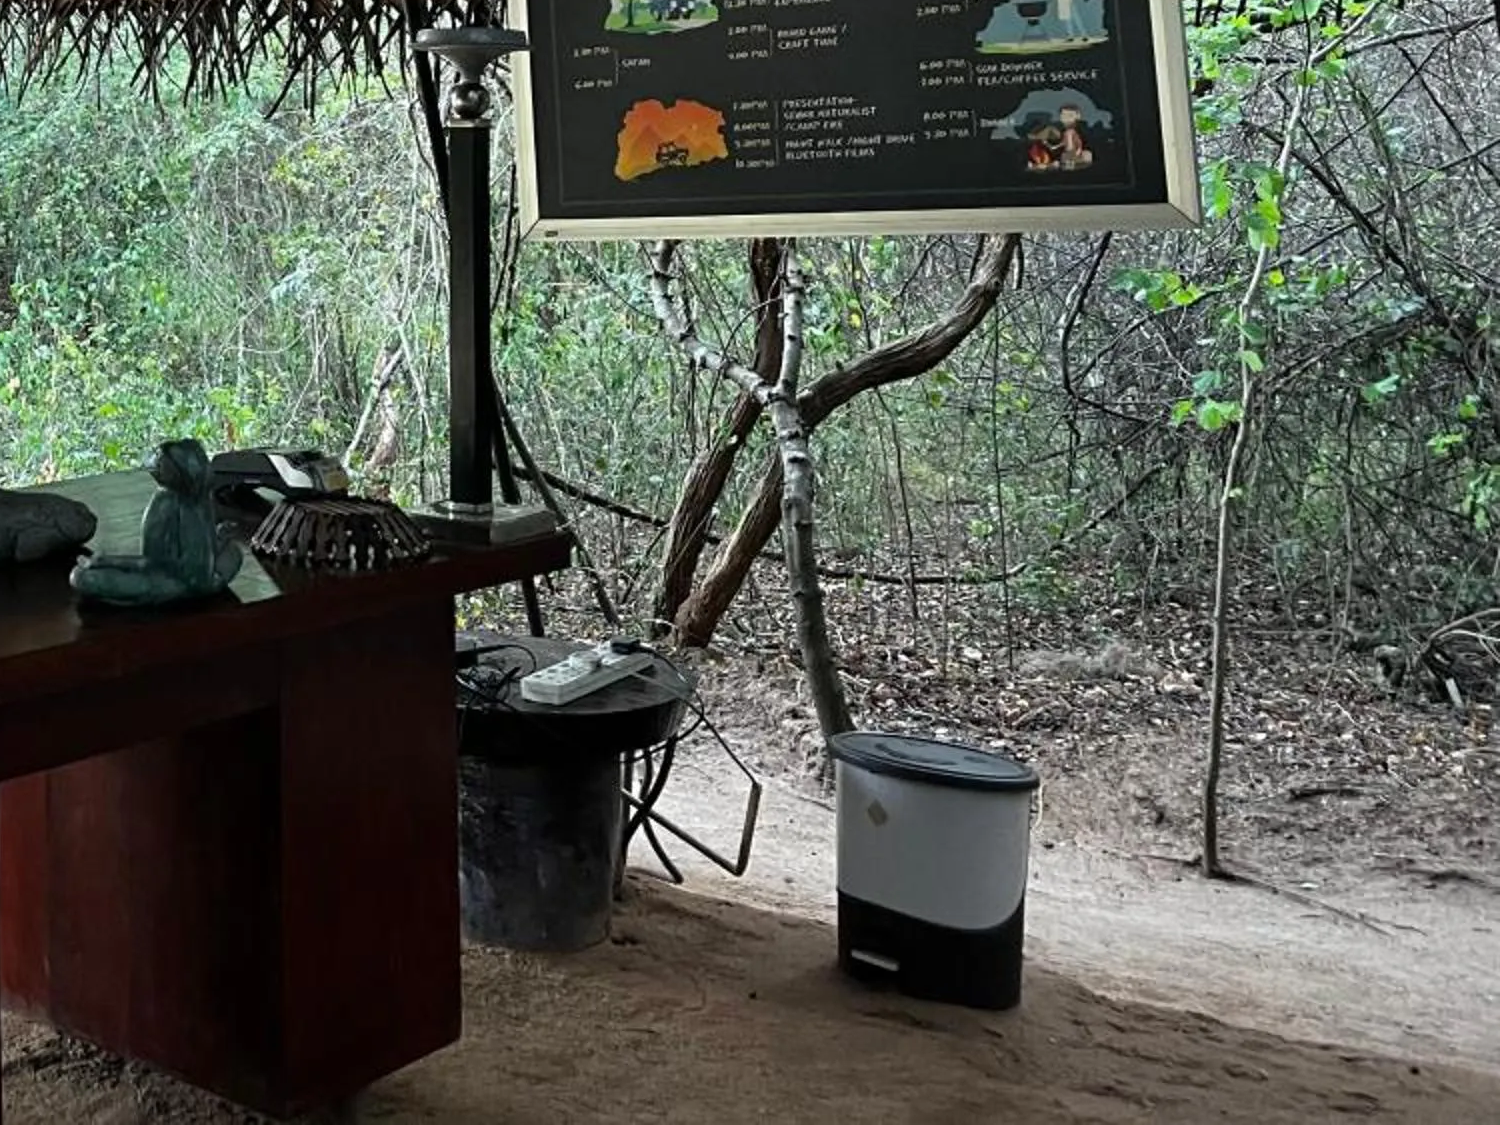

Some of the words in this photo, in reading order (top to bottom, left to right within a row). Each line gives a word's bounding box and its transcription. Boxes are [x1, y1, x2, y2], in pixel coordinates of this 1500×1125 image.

[777, 37, 809, 50] CRAFT
[1051, 68, 1099, 82] SERVICE
[817, 105, 876, 118] NATURALIST
